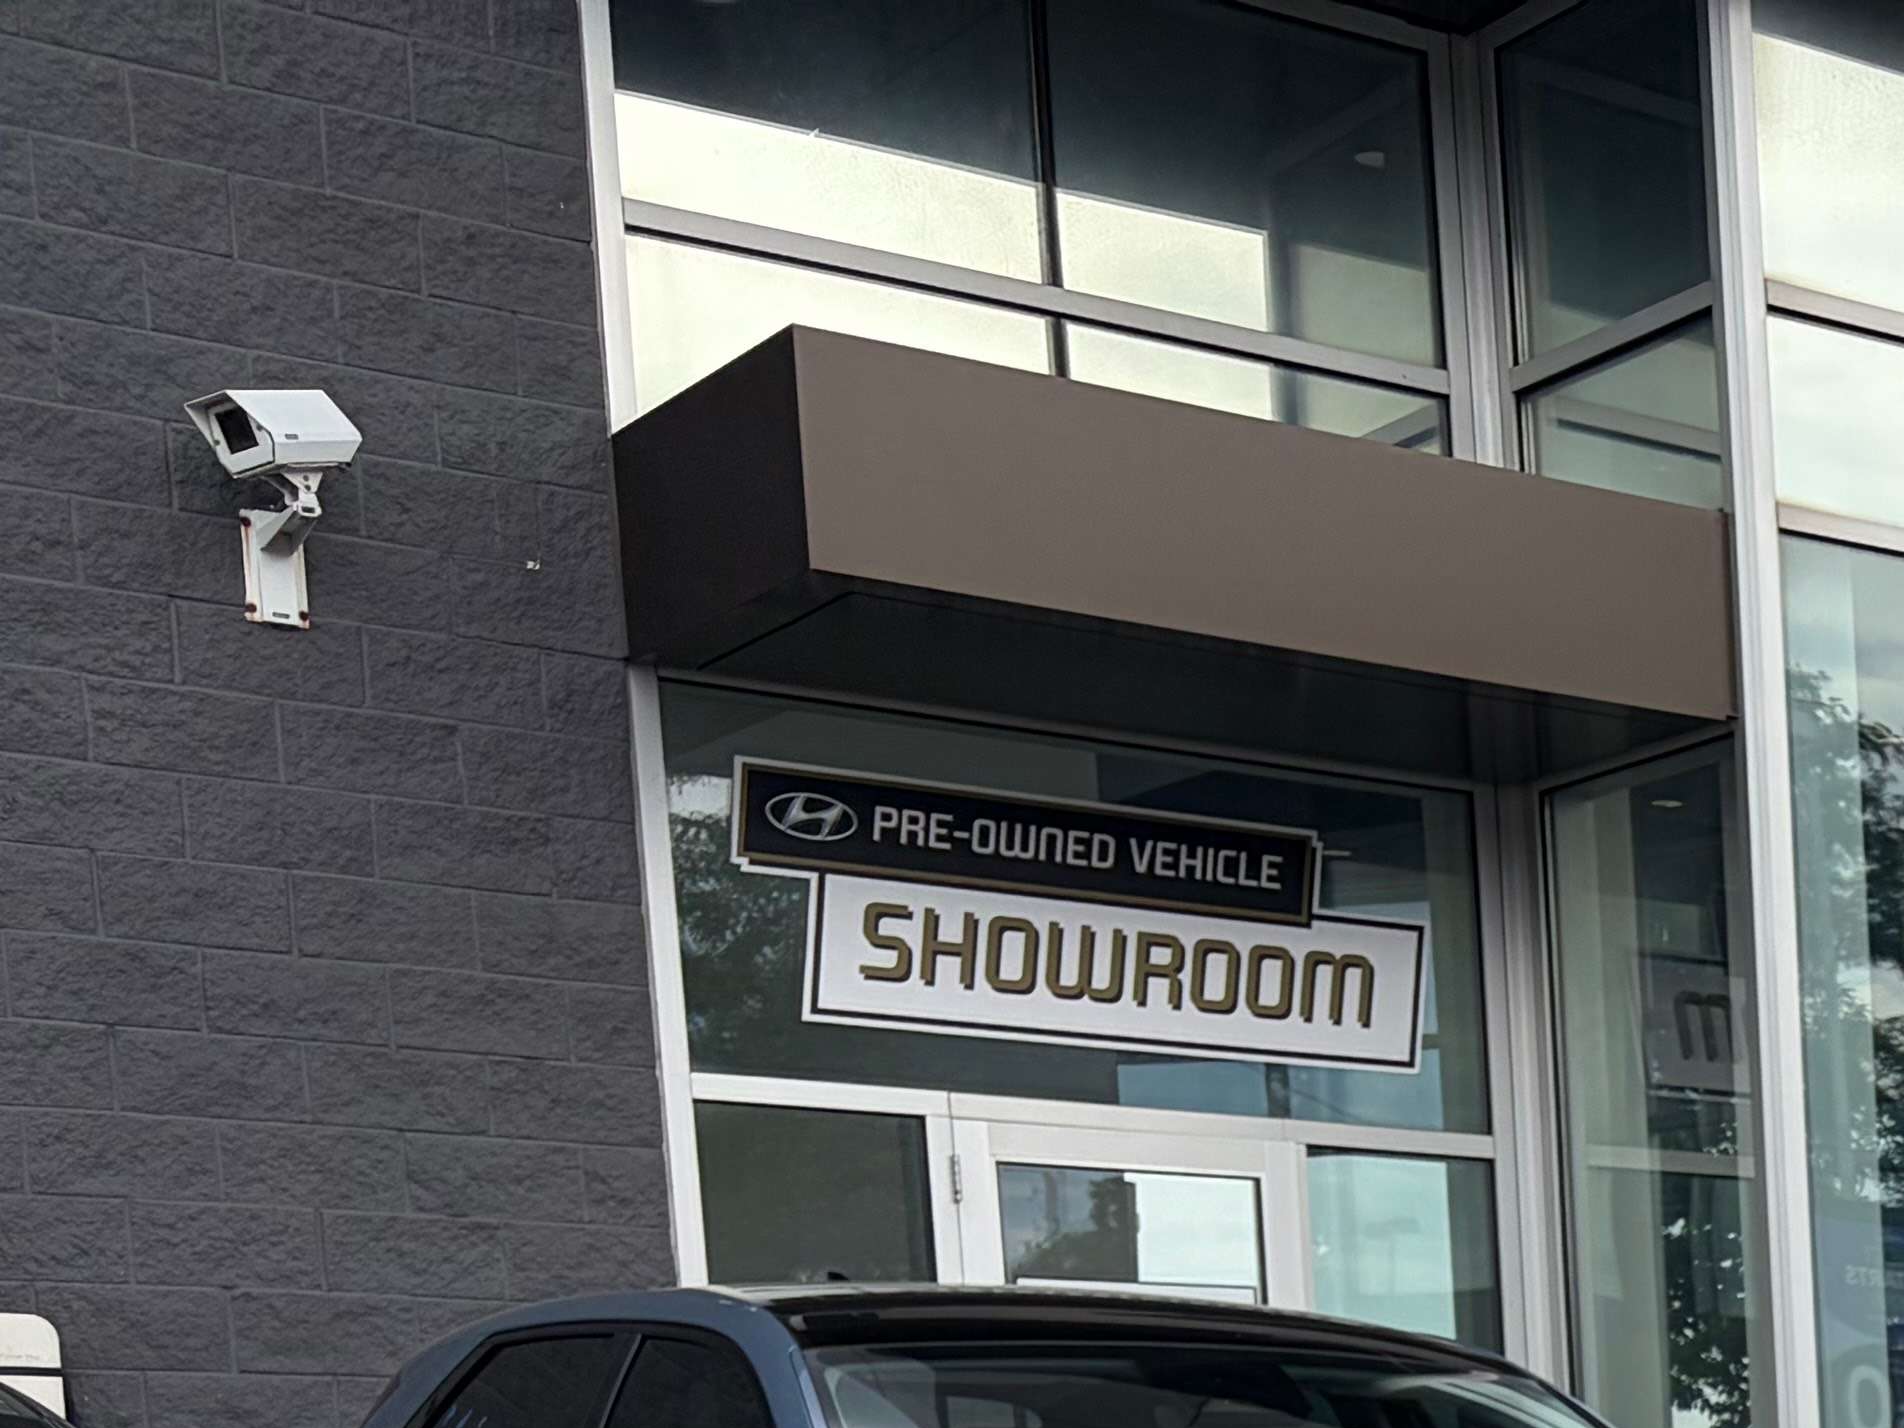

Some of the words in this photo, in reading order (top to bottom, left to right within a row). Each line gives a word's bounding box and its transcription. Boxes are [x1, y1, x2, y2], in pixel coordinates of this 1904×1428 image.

[871, 805, 1116, 869] PRE-OWNED
[1130, 839, 1284, 890] VEHICLE
[859, 902, 1376, 1028] SHOWROOM
